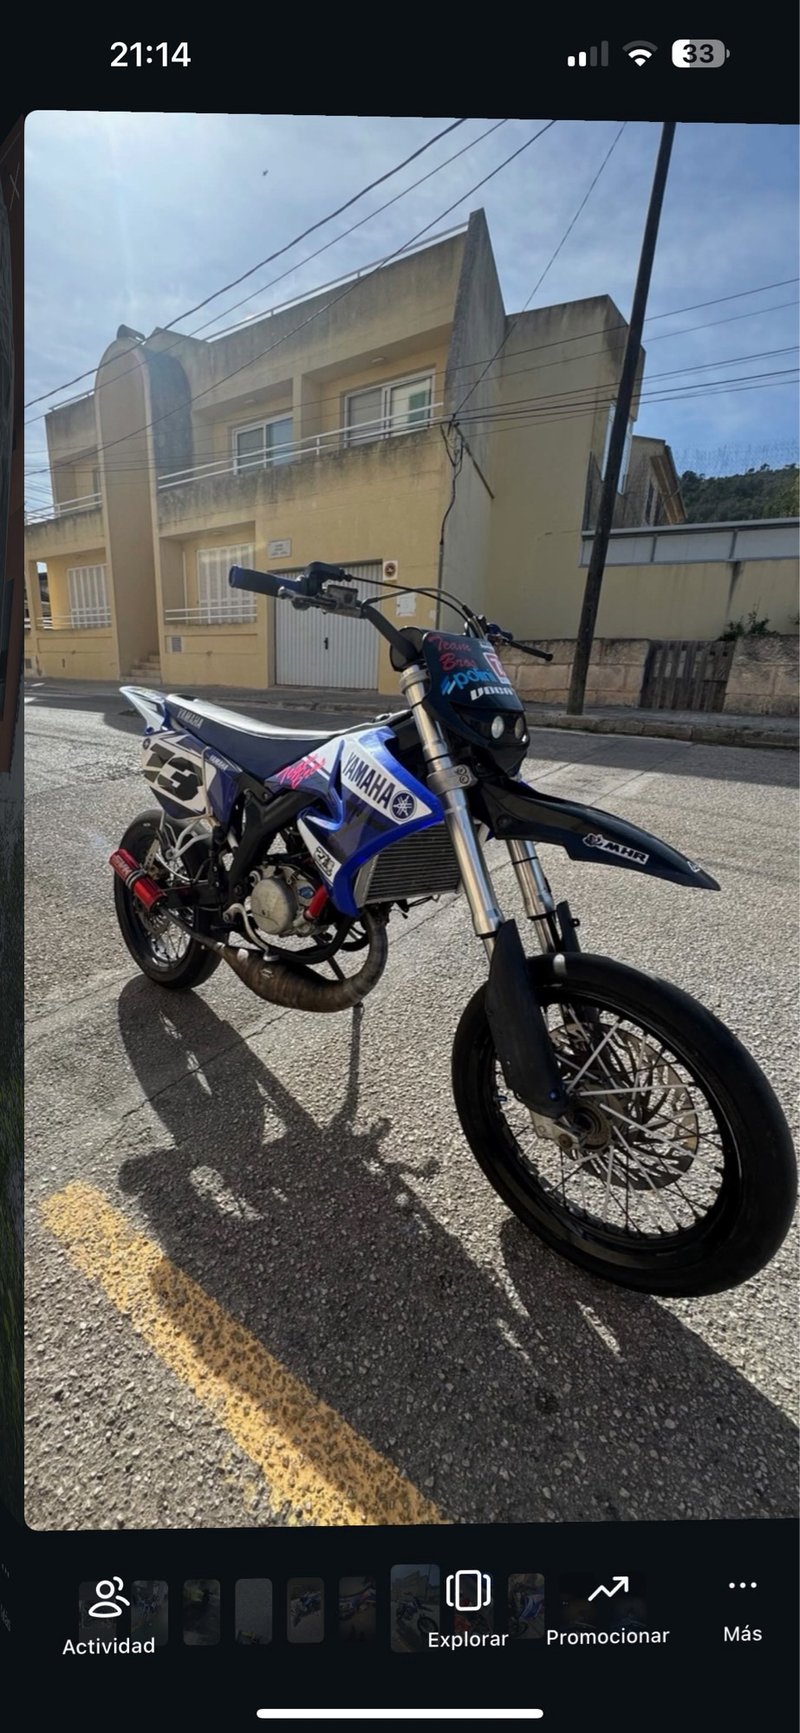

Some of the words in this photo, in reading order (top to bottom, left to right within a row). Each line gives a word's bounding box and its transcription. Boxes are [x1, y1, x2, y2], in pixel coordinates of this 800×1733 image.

[427, 636, 470, 651] Team
[176, 707, 204, 730] YAMAHA
[342, 751, 396, 809] YAMAHA
[605, 843, 646, 862] MHR
